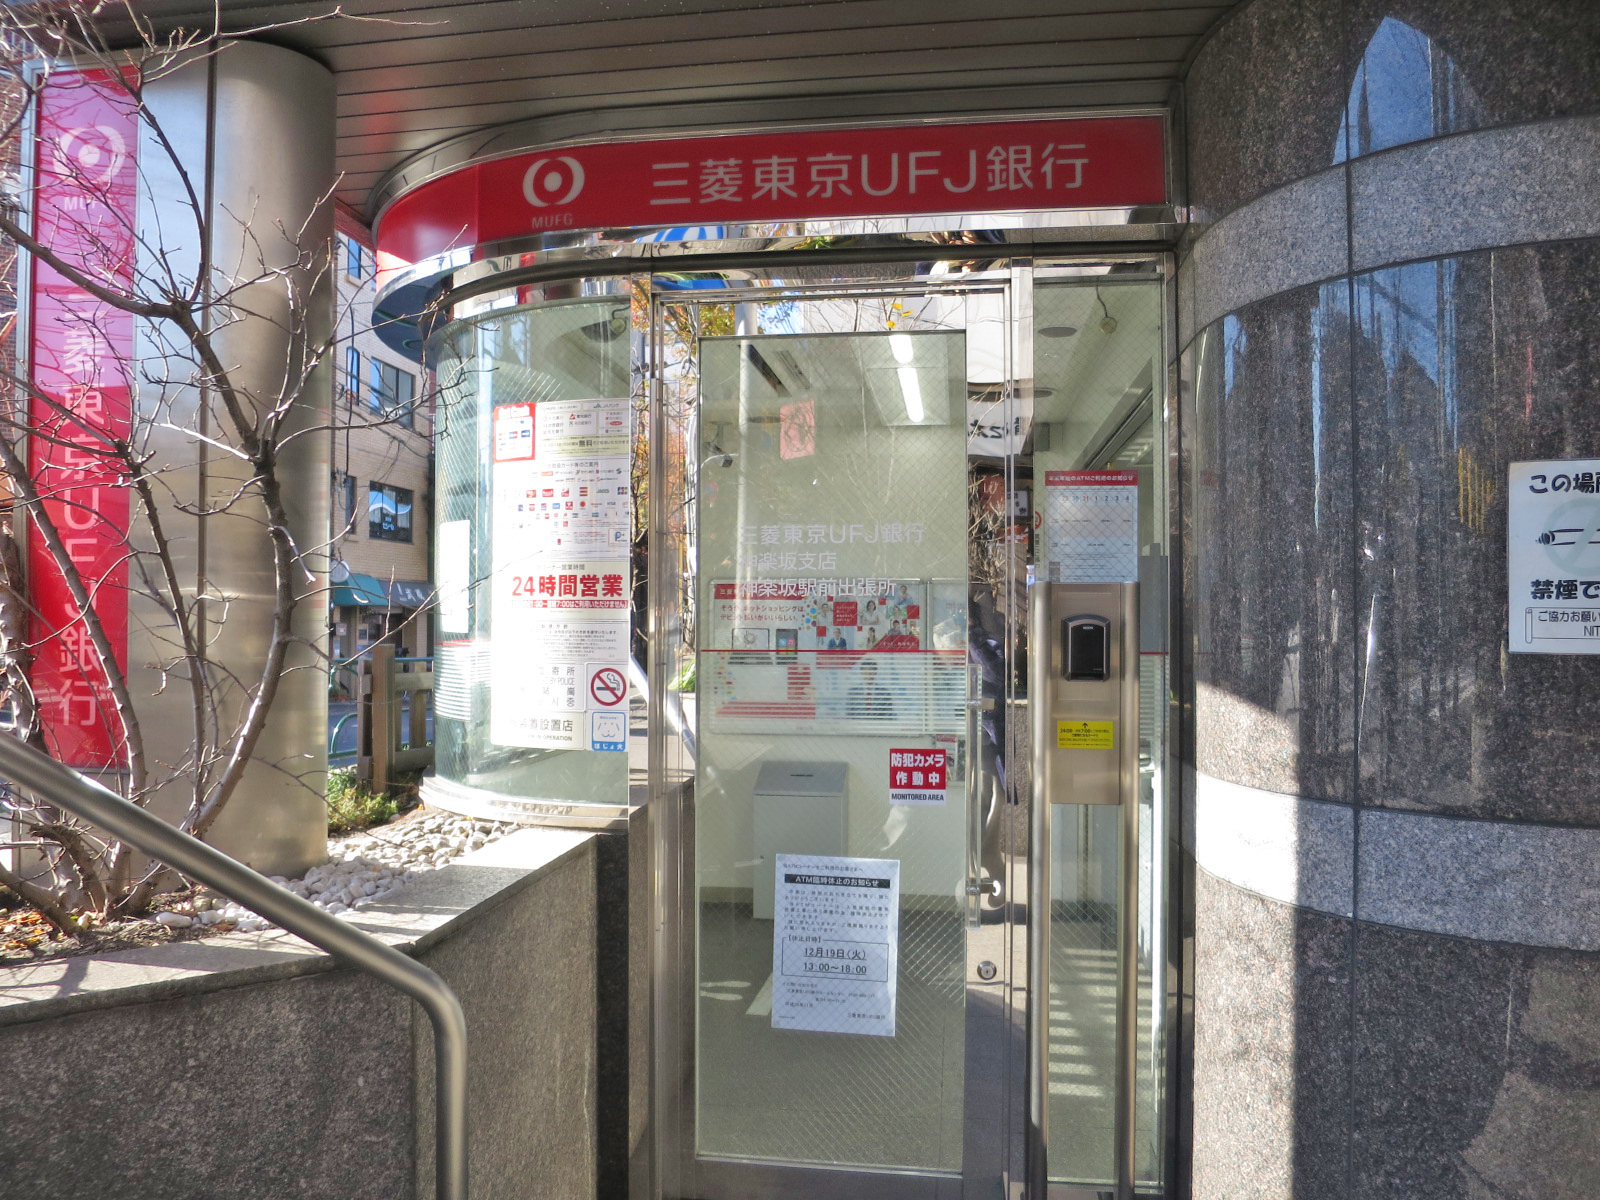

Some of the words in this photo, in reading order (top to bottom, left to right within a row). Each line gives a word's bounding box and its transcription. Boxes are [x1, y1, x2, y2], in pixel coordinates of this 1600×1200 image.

[650, 142, 1090, 206] 三菱東京UFJ銀行
[64, 197, 107, 212] MUF
[531, 212, 575, 229] MUFG
[1528, 472, 1600, 494] この場
[740, 522, 926, 547] 三菱東京UFJ銀行
[740, 551, 837, 572] 神楽坂支店
[512, 574, 623, 597] 24時間営業
[739, 577, 897, 599] 神楽坂駅前出張所
[1530, 579, 1600, 600] 禁煙で
[891, 753, 945, 767] 防犯カメラ
[896, 771, 940, 786] 作動中
[891, 793, 927, 801] MONITORED
[927, 794, 945, 802] AREA
[795, 875, 879, 888] ATM臨時休止のお知らせ
[786, 935, 823, 944] 【休止日時】
